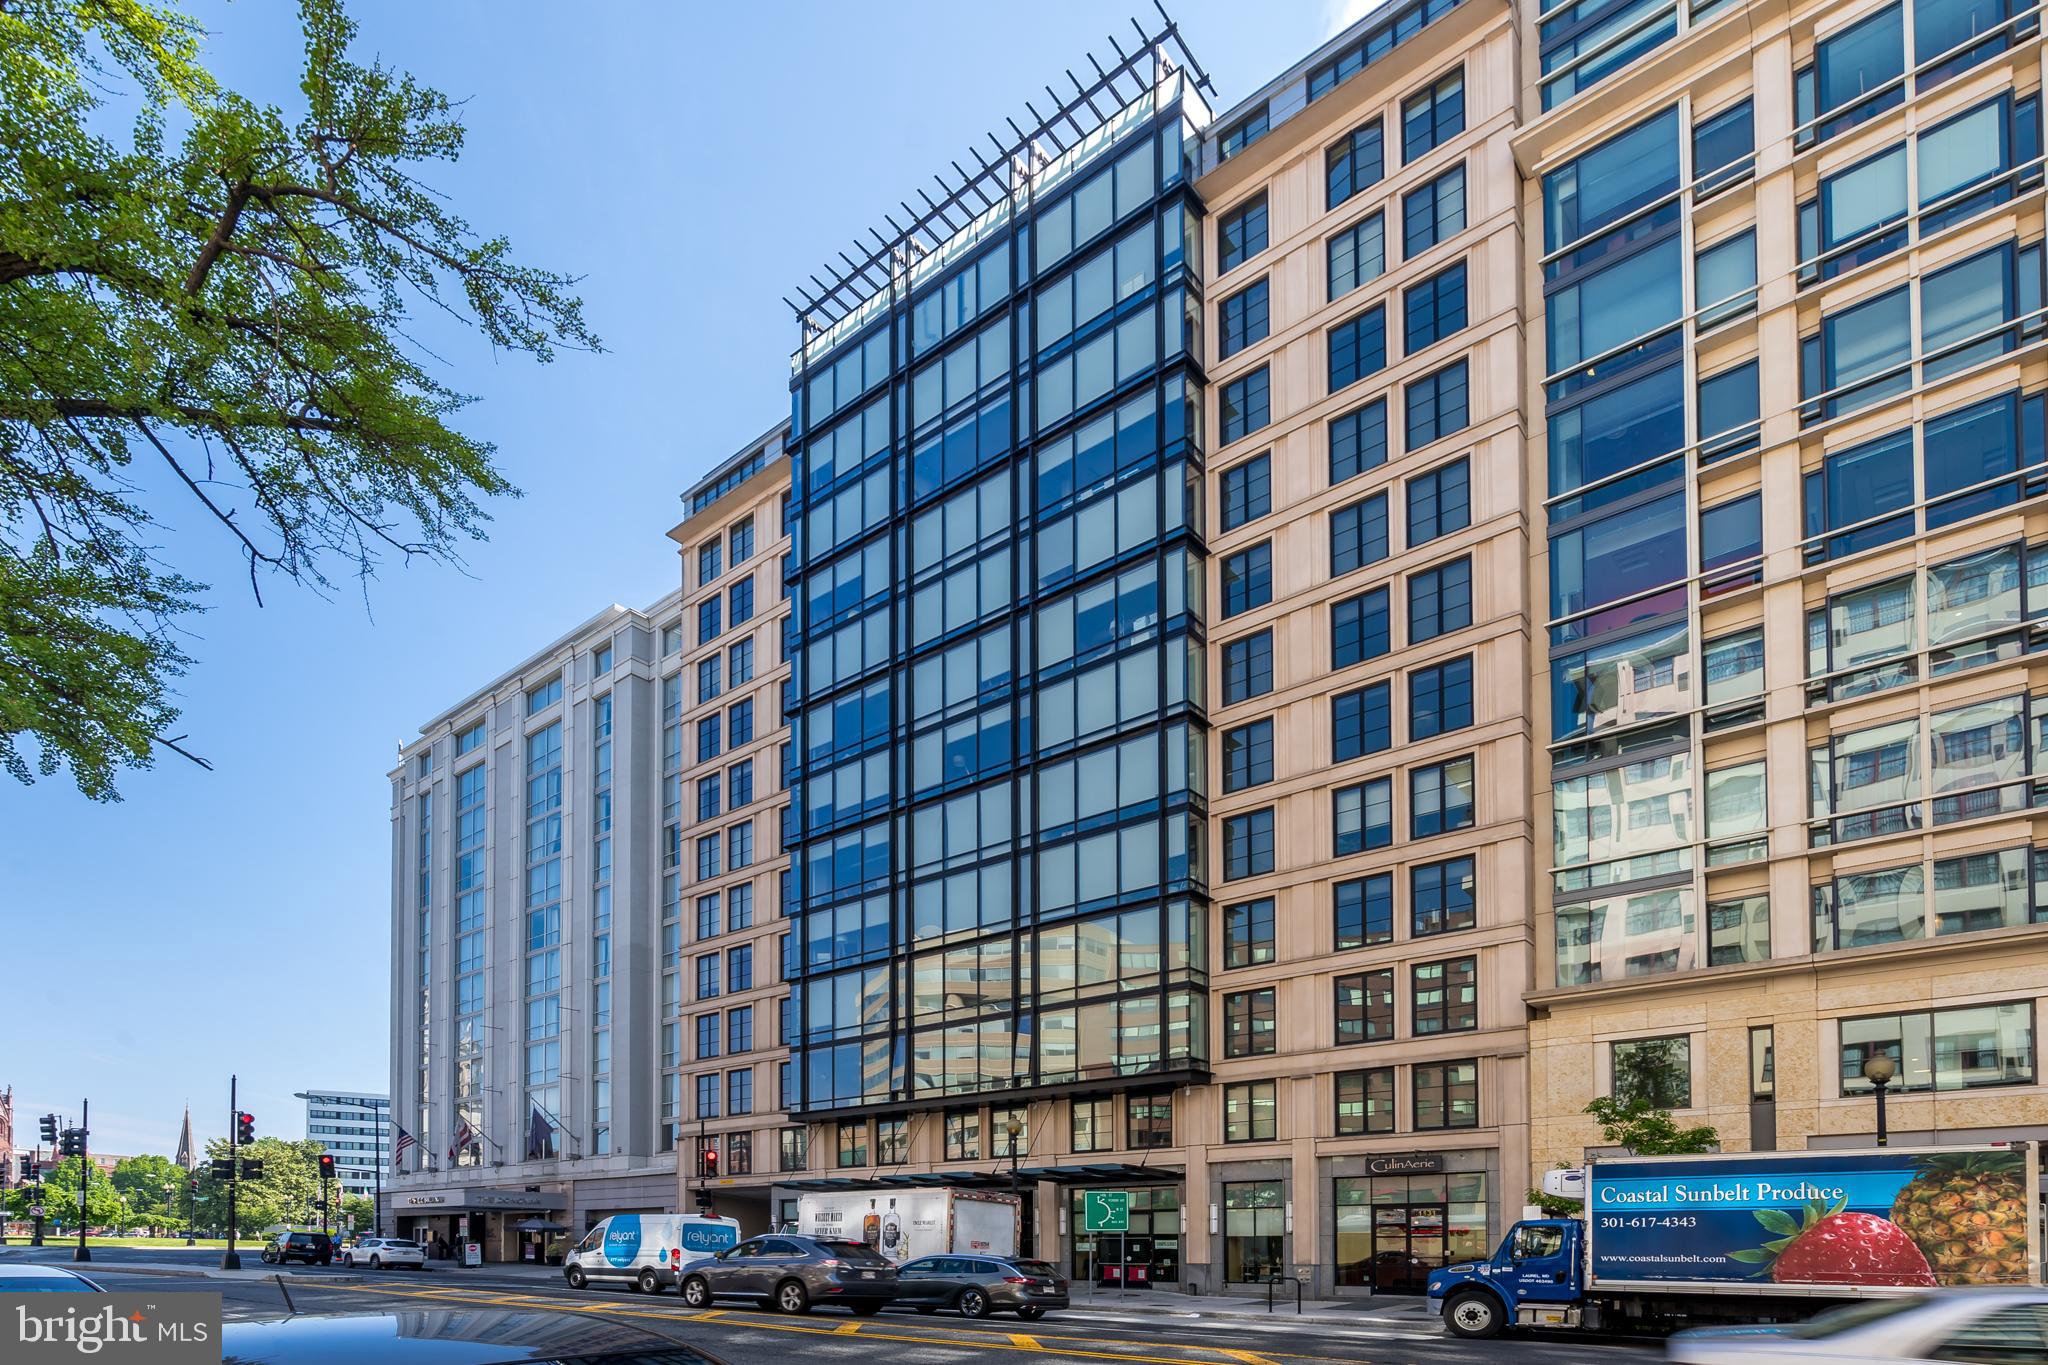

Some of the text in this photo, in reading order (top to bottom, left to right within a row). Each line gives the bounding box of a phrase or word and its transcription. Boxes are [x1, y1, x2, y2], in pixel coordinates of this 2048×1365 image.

[1371, 1158, 1435, 1173] CulinAerie
[1601, 1182, 1844, 1204] Coastal Sunbelt Produce
[1601, 1217, 1697, 1228] 301-617-4343
[609, 1229, 635, 1243] relyant
[687, 1231, 729, 1246] relyant
[1601, 1253, 1726, 1263] www.coastalsunbelt.com
